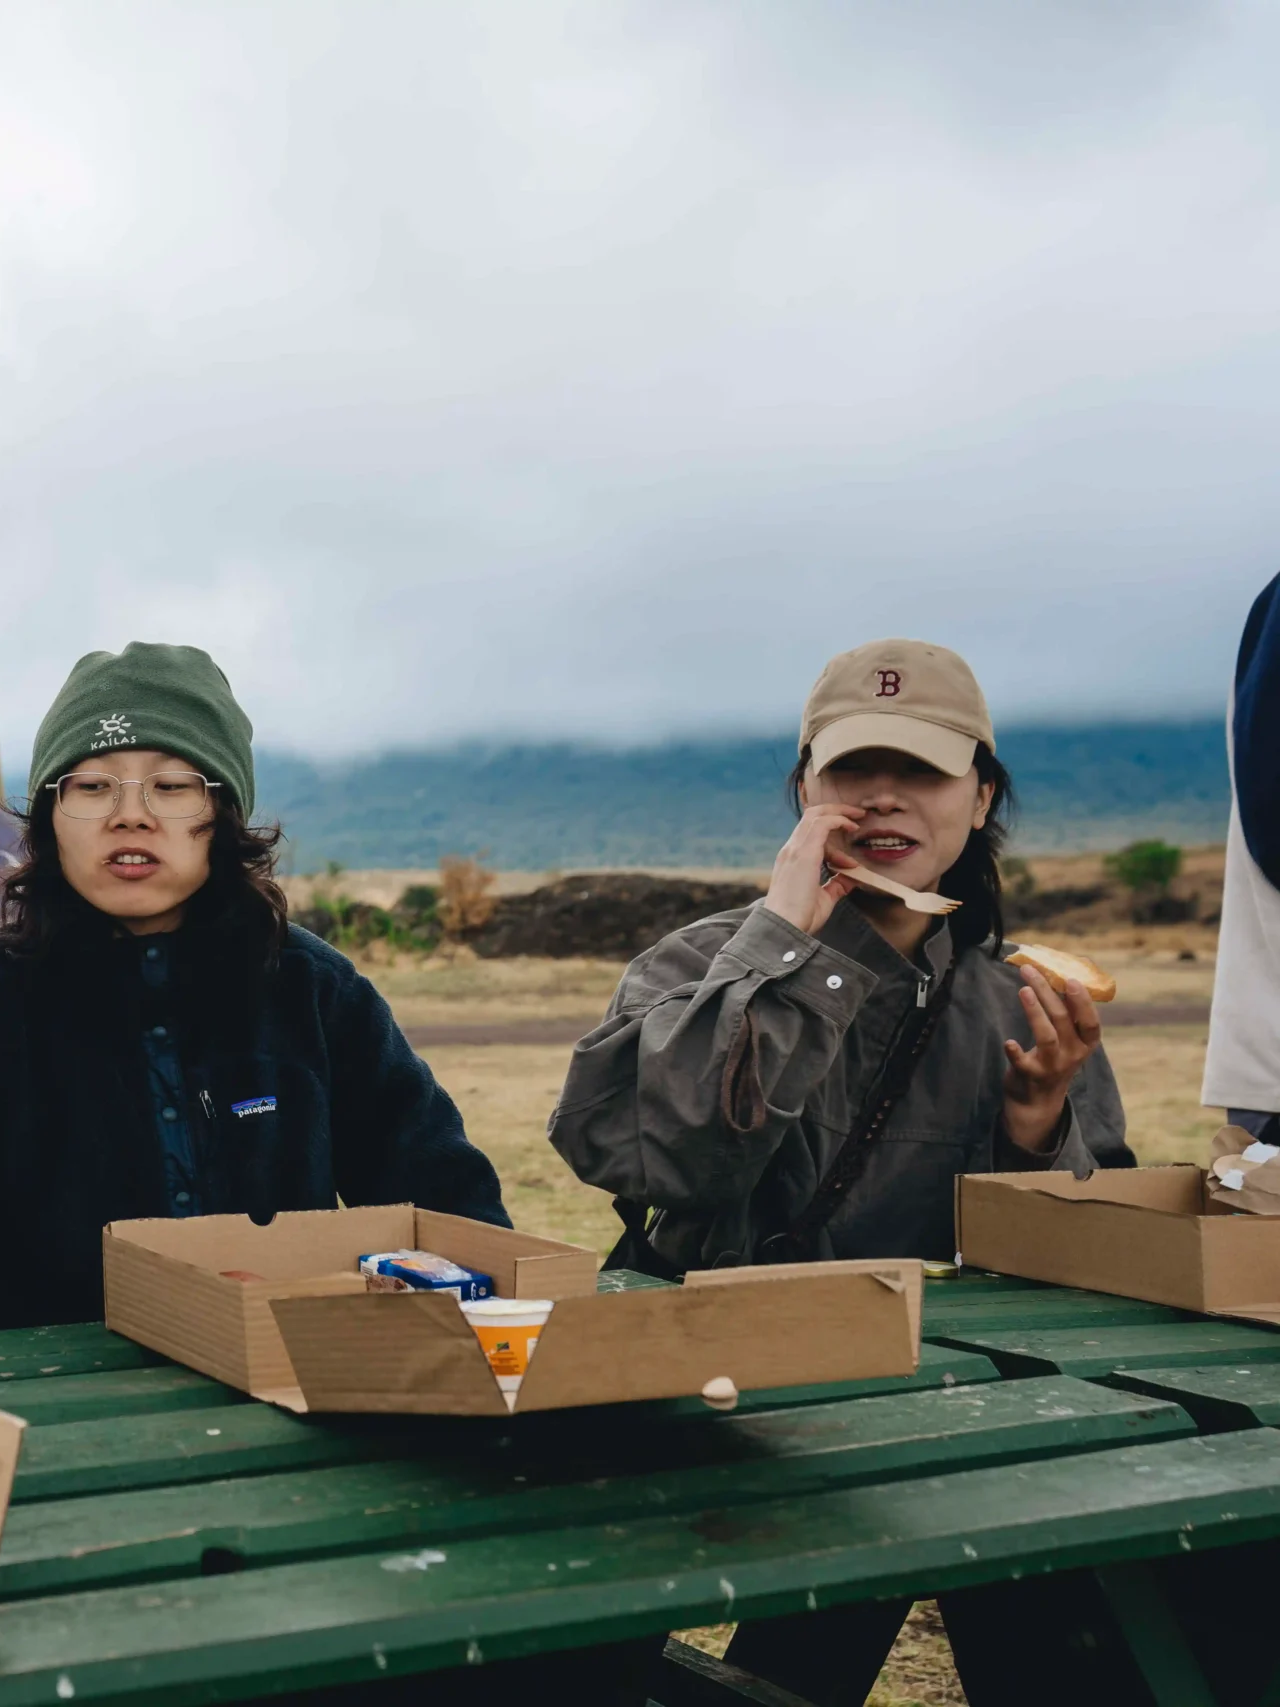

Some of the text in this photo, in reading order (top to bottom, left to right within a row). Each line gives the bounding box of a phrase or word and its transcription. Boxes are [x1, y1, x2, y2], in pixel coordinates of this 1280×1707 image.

[874, 669, 902, 697] B
[90, 735, 137, 751] KAILAS
[237, 1103, 277, 1118] patagonia
